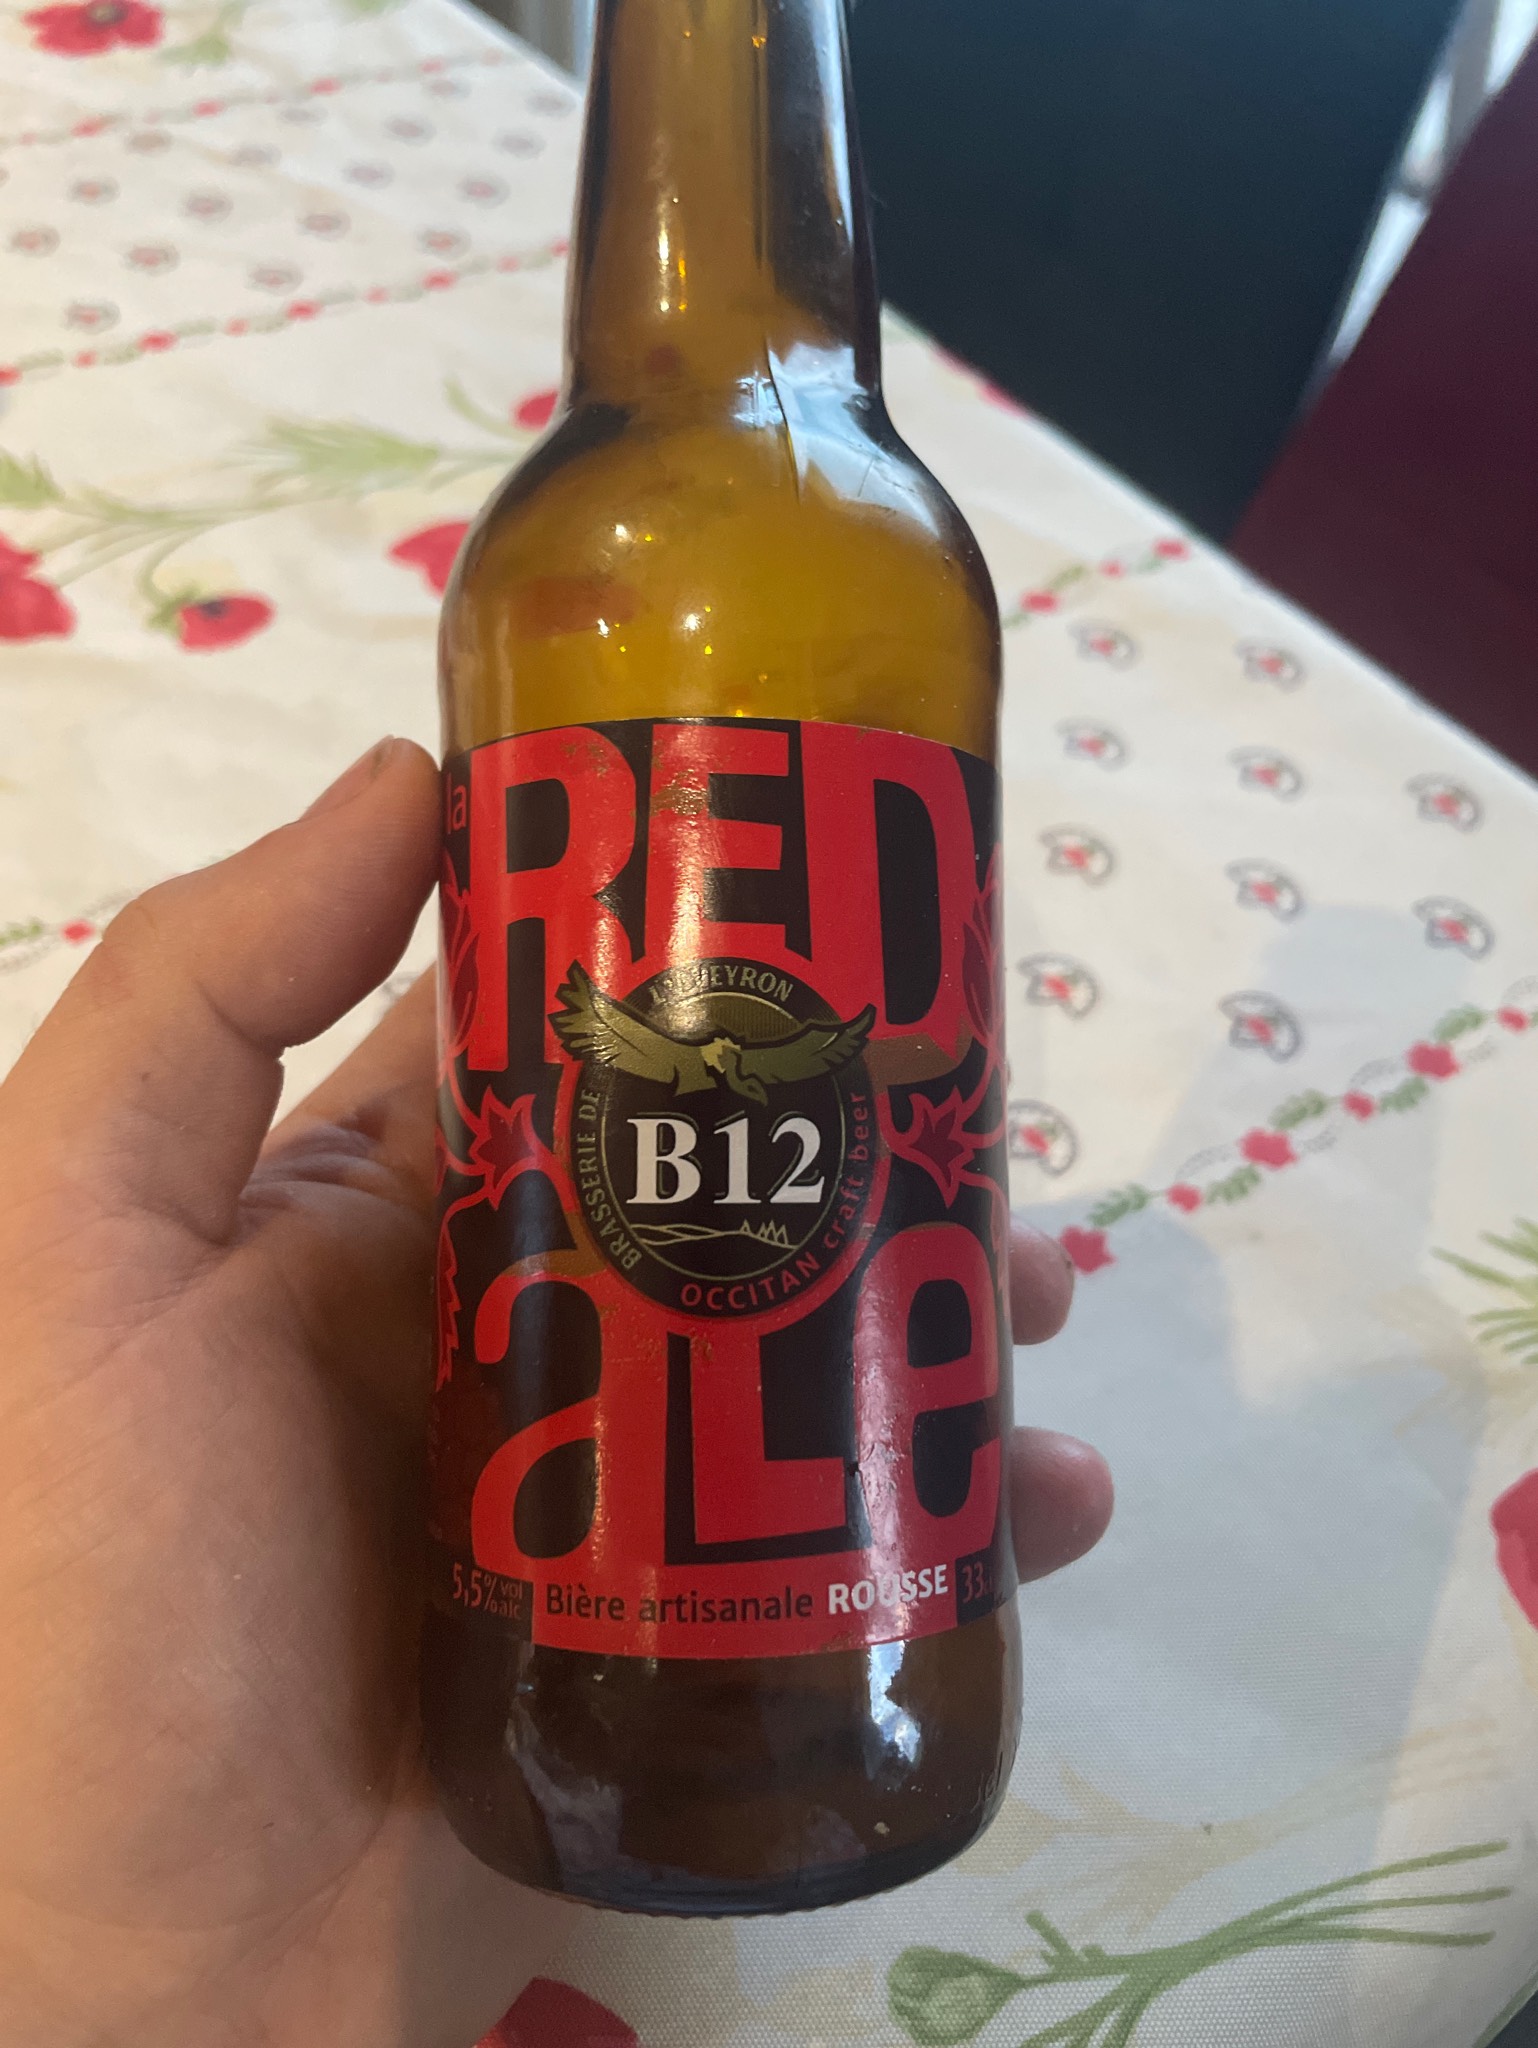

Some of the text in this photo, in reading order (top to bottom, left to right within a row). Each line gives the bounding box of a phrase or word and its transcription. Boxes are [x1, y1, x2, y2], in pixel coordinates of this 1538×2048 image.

[446, 773, 467, 834] la
[470, 720, 976, 1071] RED
[577, 964, 794, 1269] BRASSERIE DE L'EYRON
[626, 1117, 825, 1204] B12
[680, 1092, 870, 1311] OCCITAN craft beer
[453, 1562, 499, 1613] 5,5%
[546, 1563, 948, 1624] Bière artisanale ROUSSE
